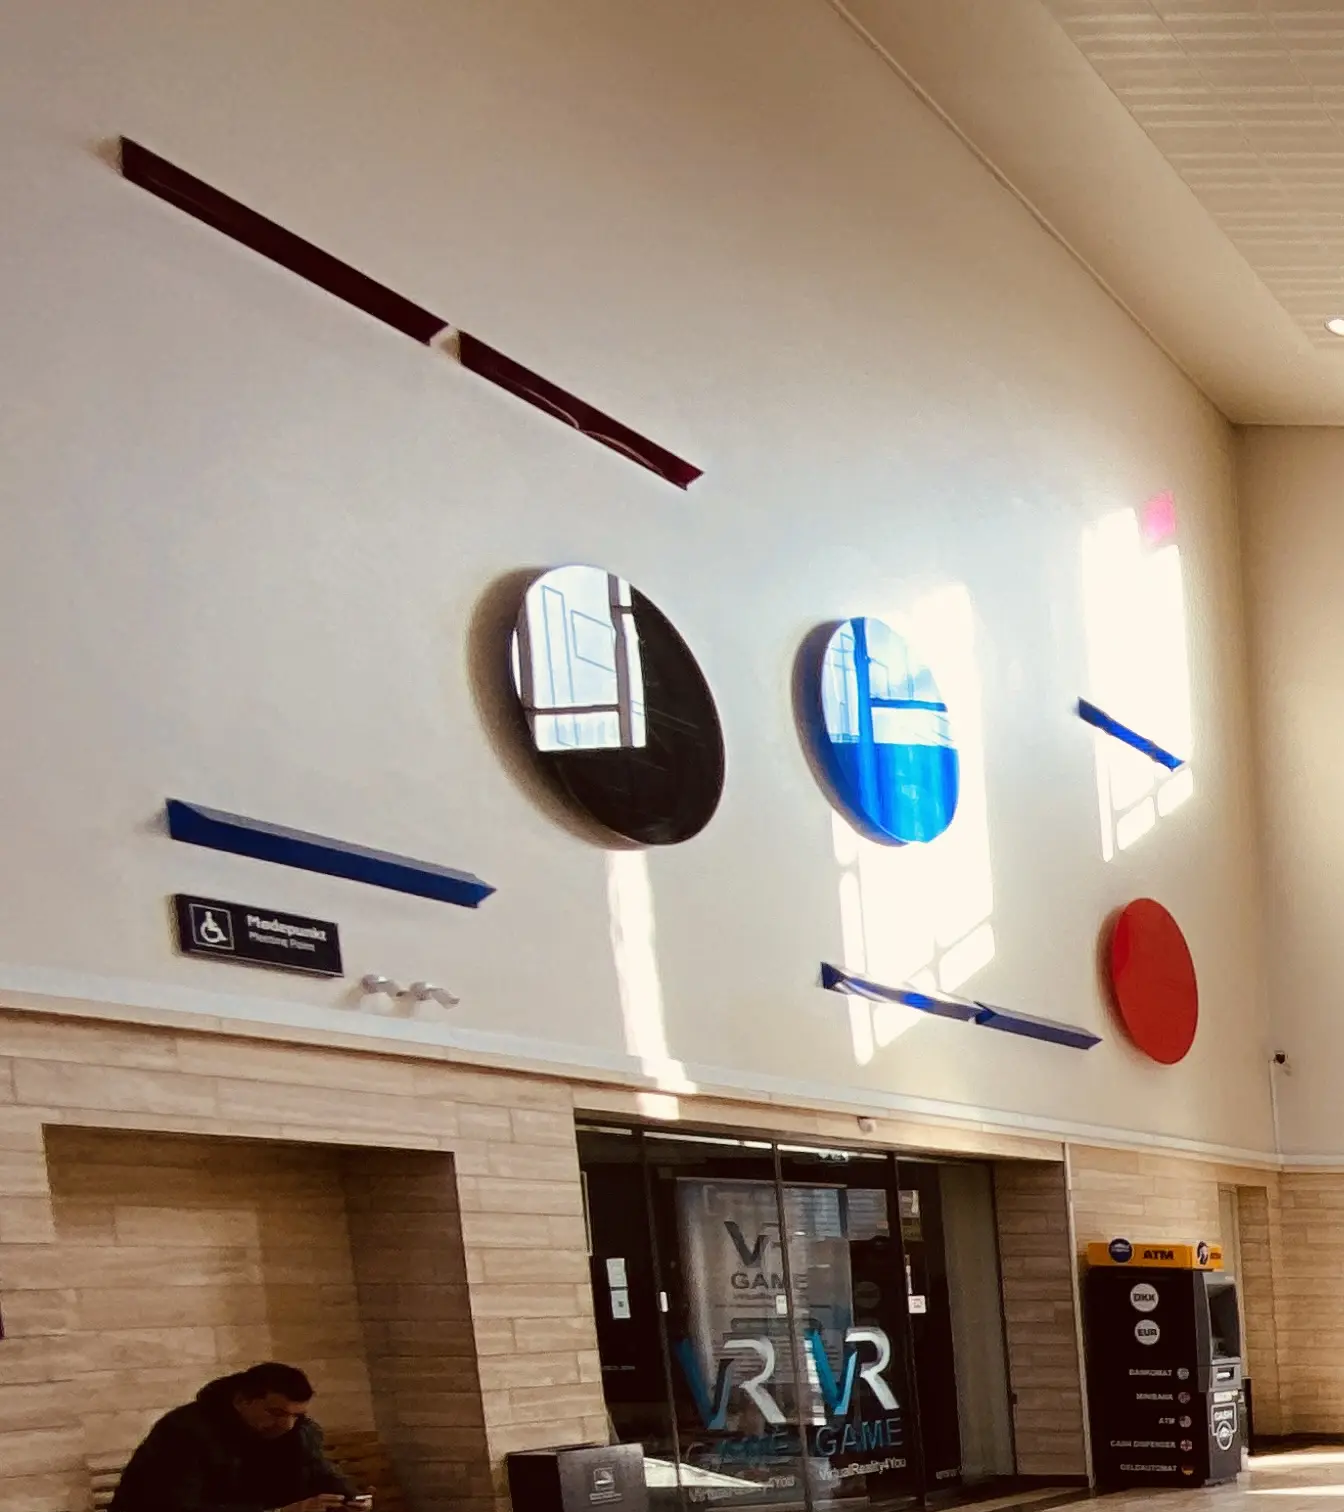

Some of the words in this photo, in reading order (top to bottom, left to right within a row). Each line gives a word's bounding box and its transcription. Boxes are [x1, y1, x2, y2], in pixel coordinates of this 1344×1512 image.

[1143, 1249, 1174, 1260] ATM
[1133, 1293, 1156, 1302] DKK
[1137, 1327, 1157, 1337] EUR
[815, 1418, 903, 1456] GAME
